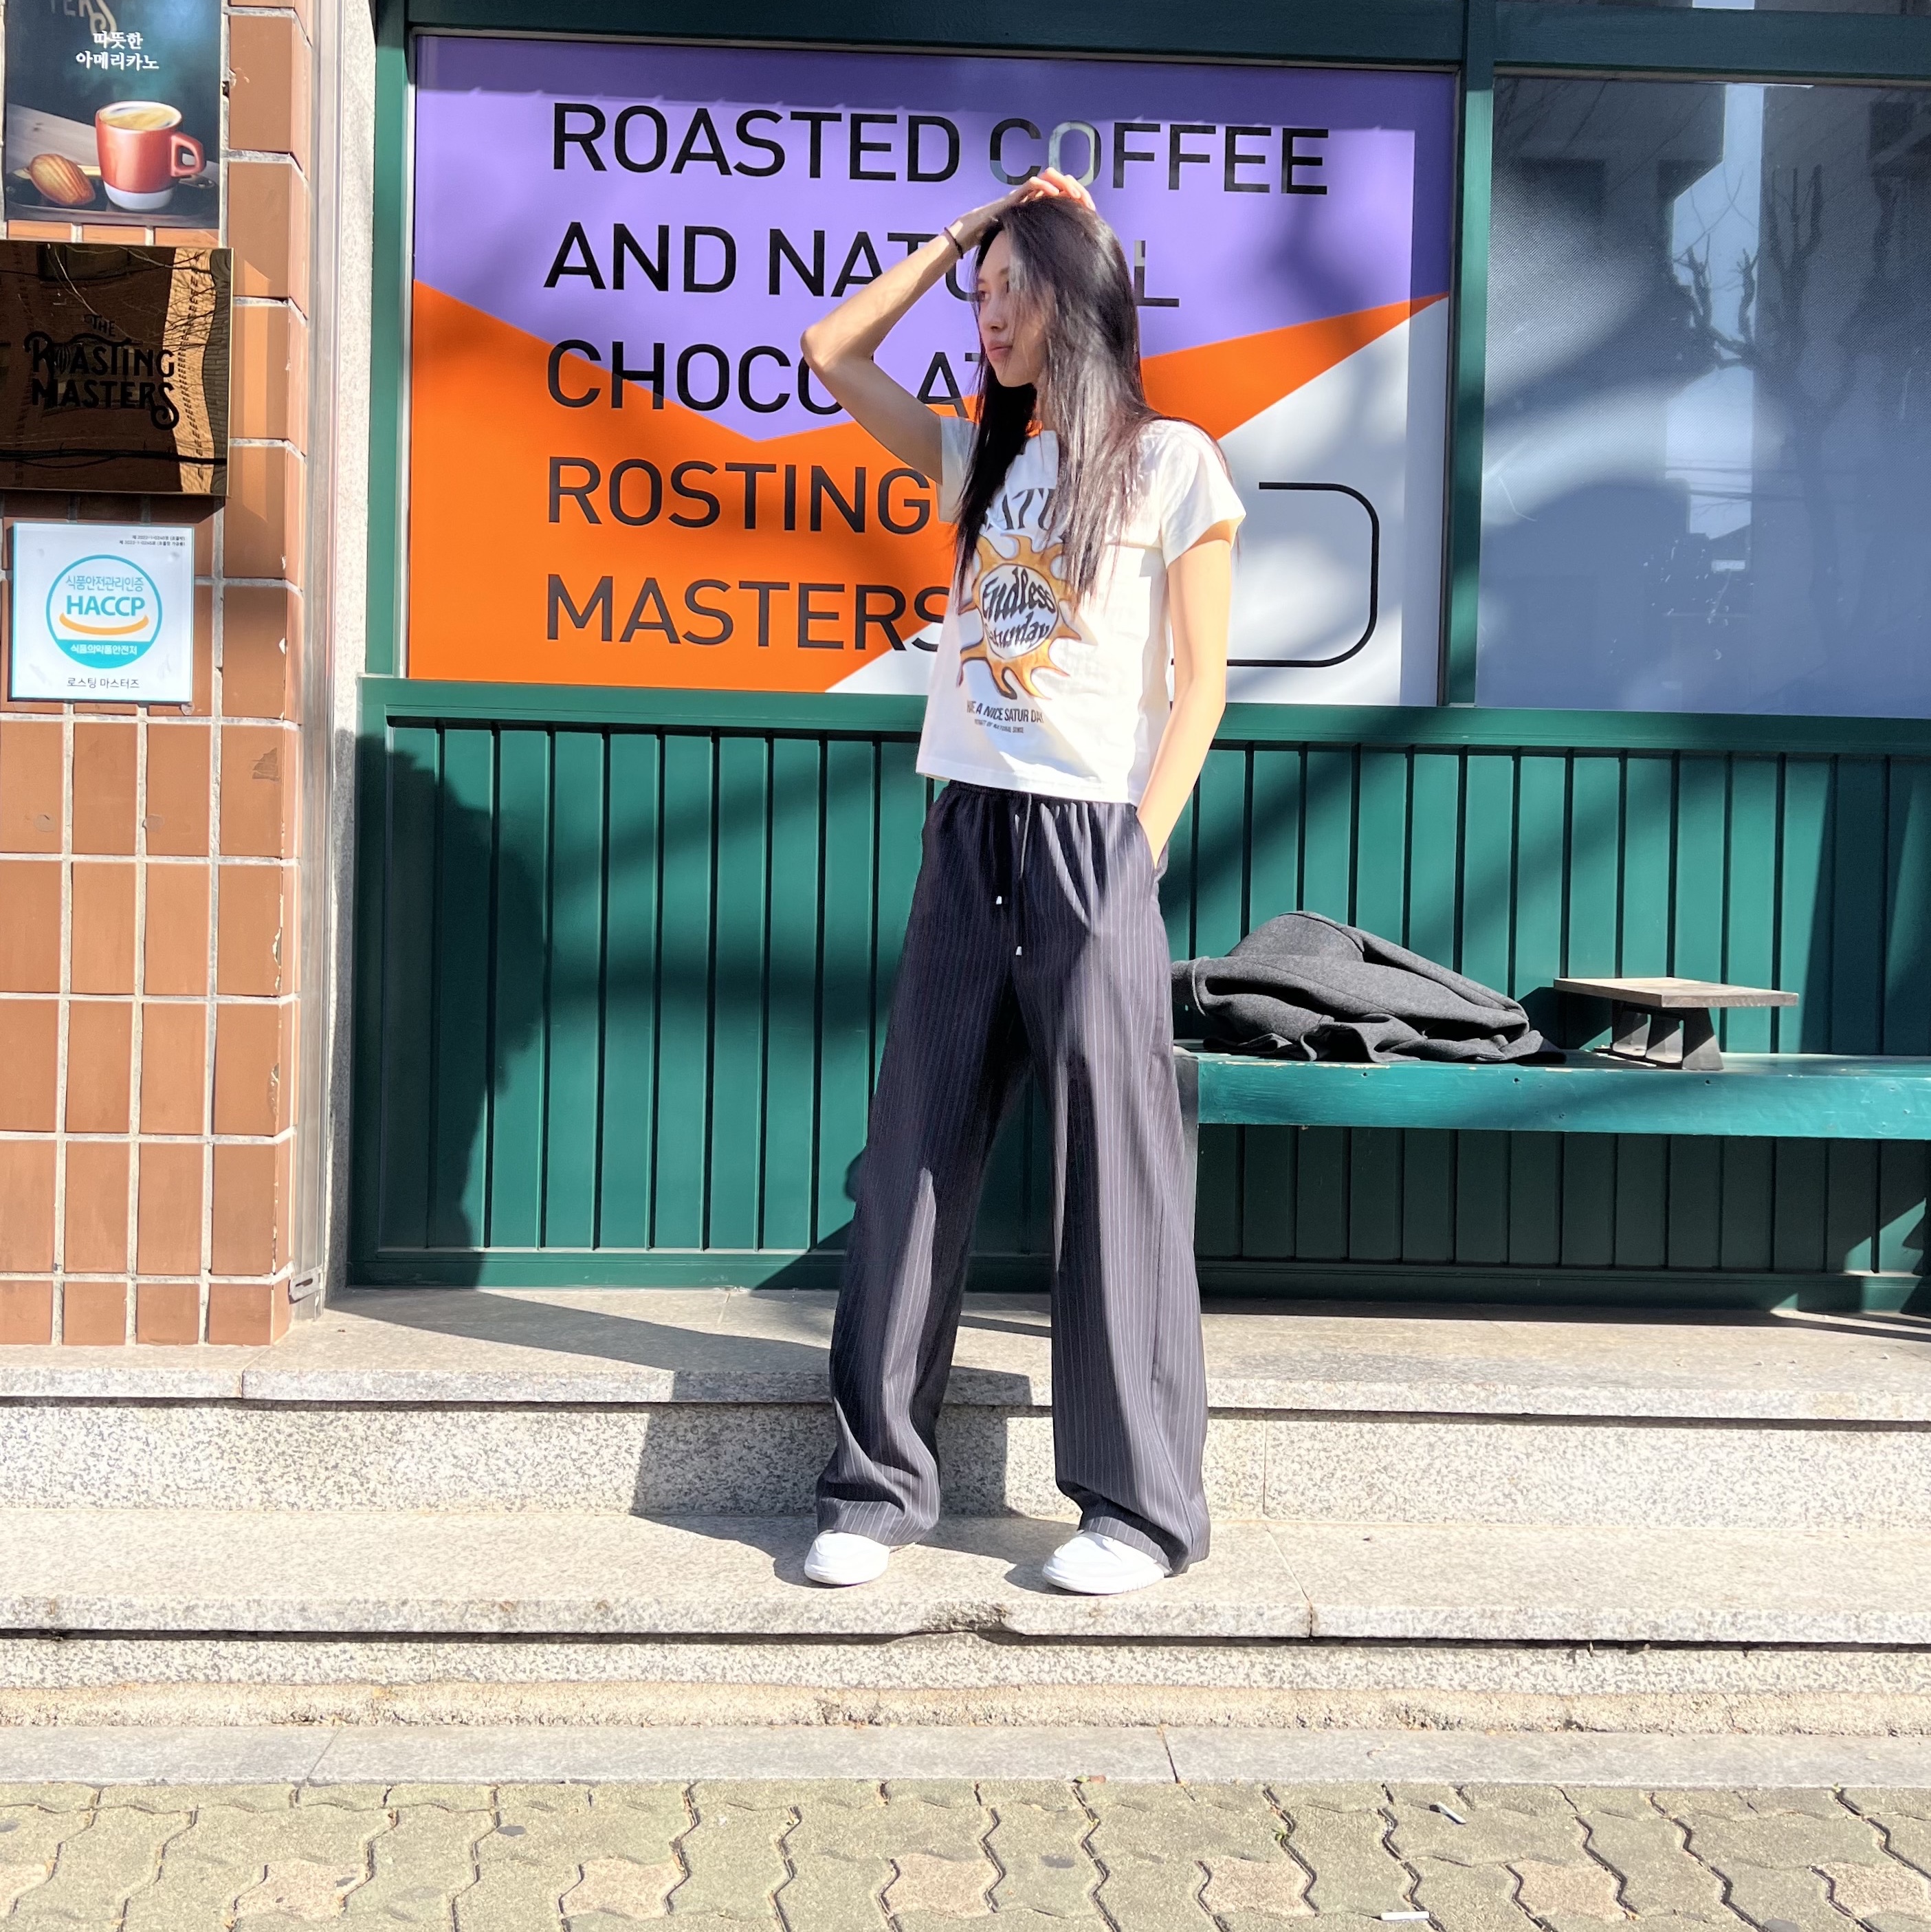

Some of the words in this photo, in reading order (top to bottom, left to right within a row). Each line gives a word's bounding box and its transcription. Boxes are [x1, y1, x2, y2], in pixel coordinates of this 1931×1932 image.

[92, 30, 144, 50] 따뜻한
[76, 50, 159, 72] 아메리카노
[553, 102, 960, 182] ROASTED
[989, 118, 1329, 195] COFFEE
[543, 221, 736, 293] AND
[769, 228, 1180, 307] NATL
[84, 314, 116, 337] THE
[31, 377, 180, 430] MASTERS
[549, 457, 930, 535] ROSTING
[66, 575, 144, 592] 식품안전관리인증
[982, 566, 1056, 623] Endless
[67, 595, 145, 617] HACCP
[547, 573, 951, 652] MASTERS
[67, 677, 96, 689] 로스팅
[100, 677, 140, 690] 마스터즈
[976, 703, 983, 715] A
[983, 705, 1004, 721] NICE
[1004, 707, 1029, 723] SATUR
